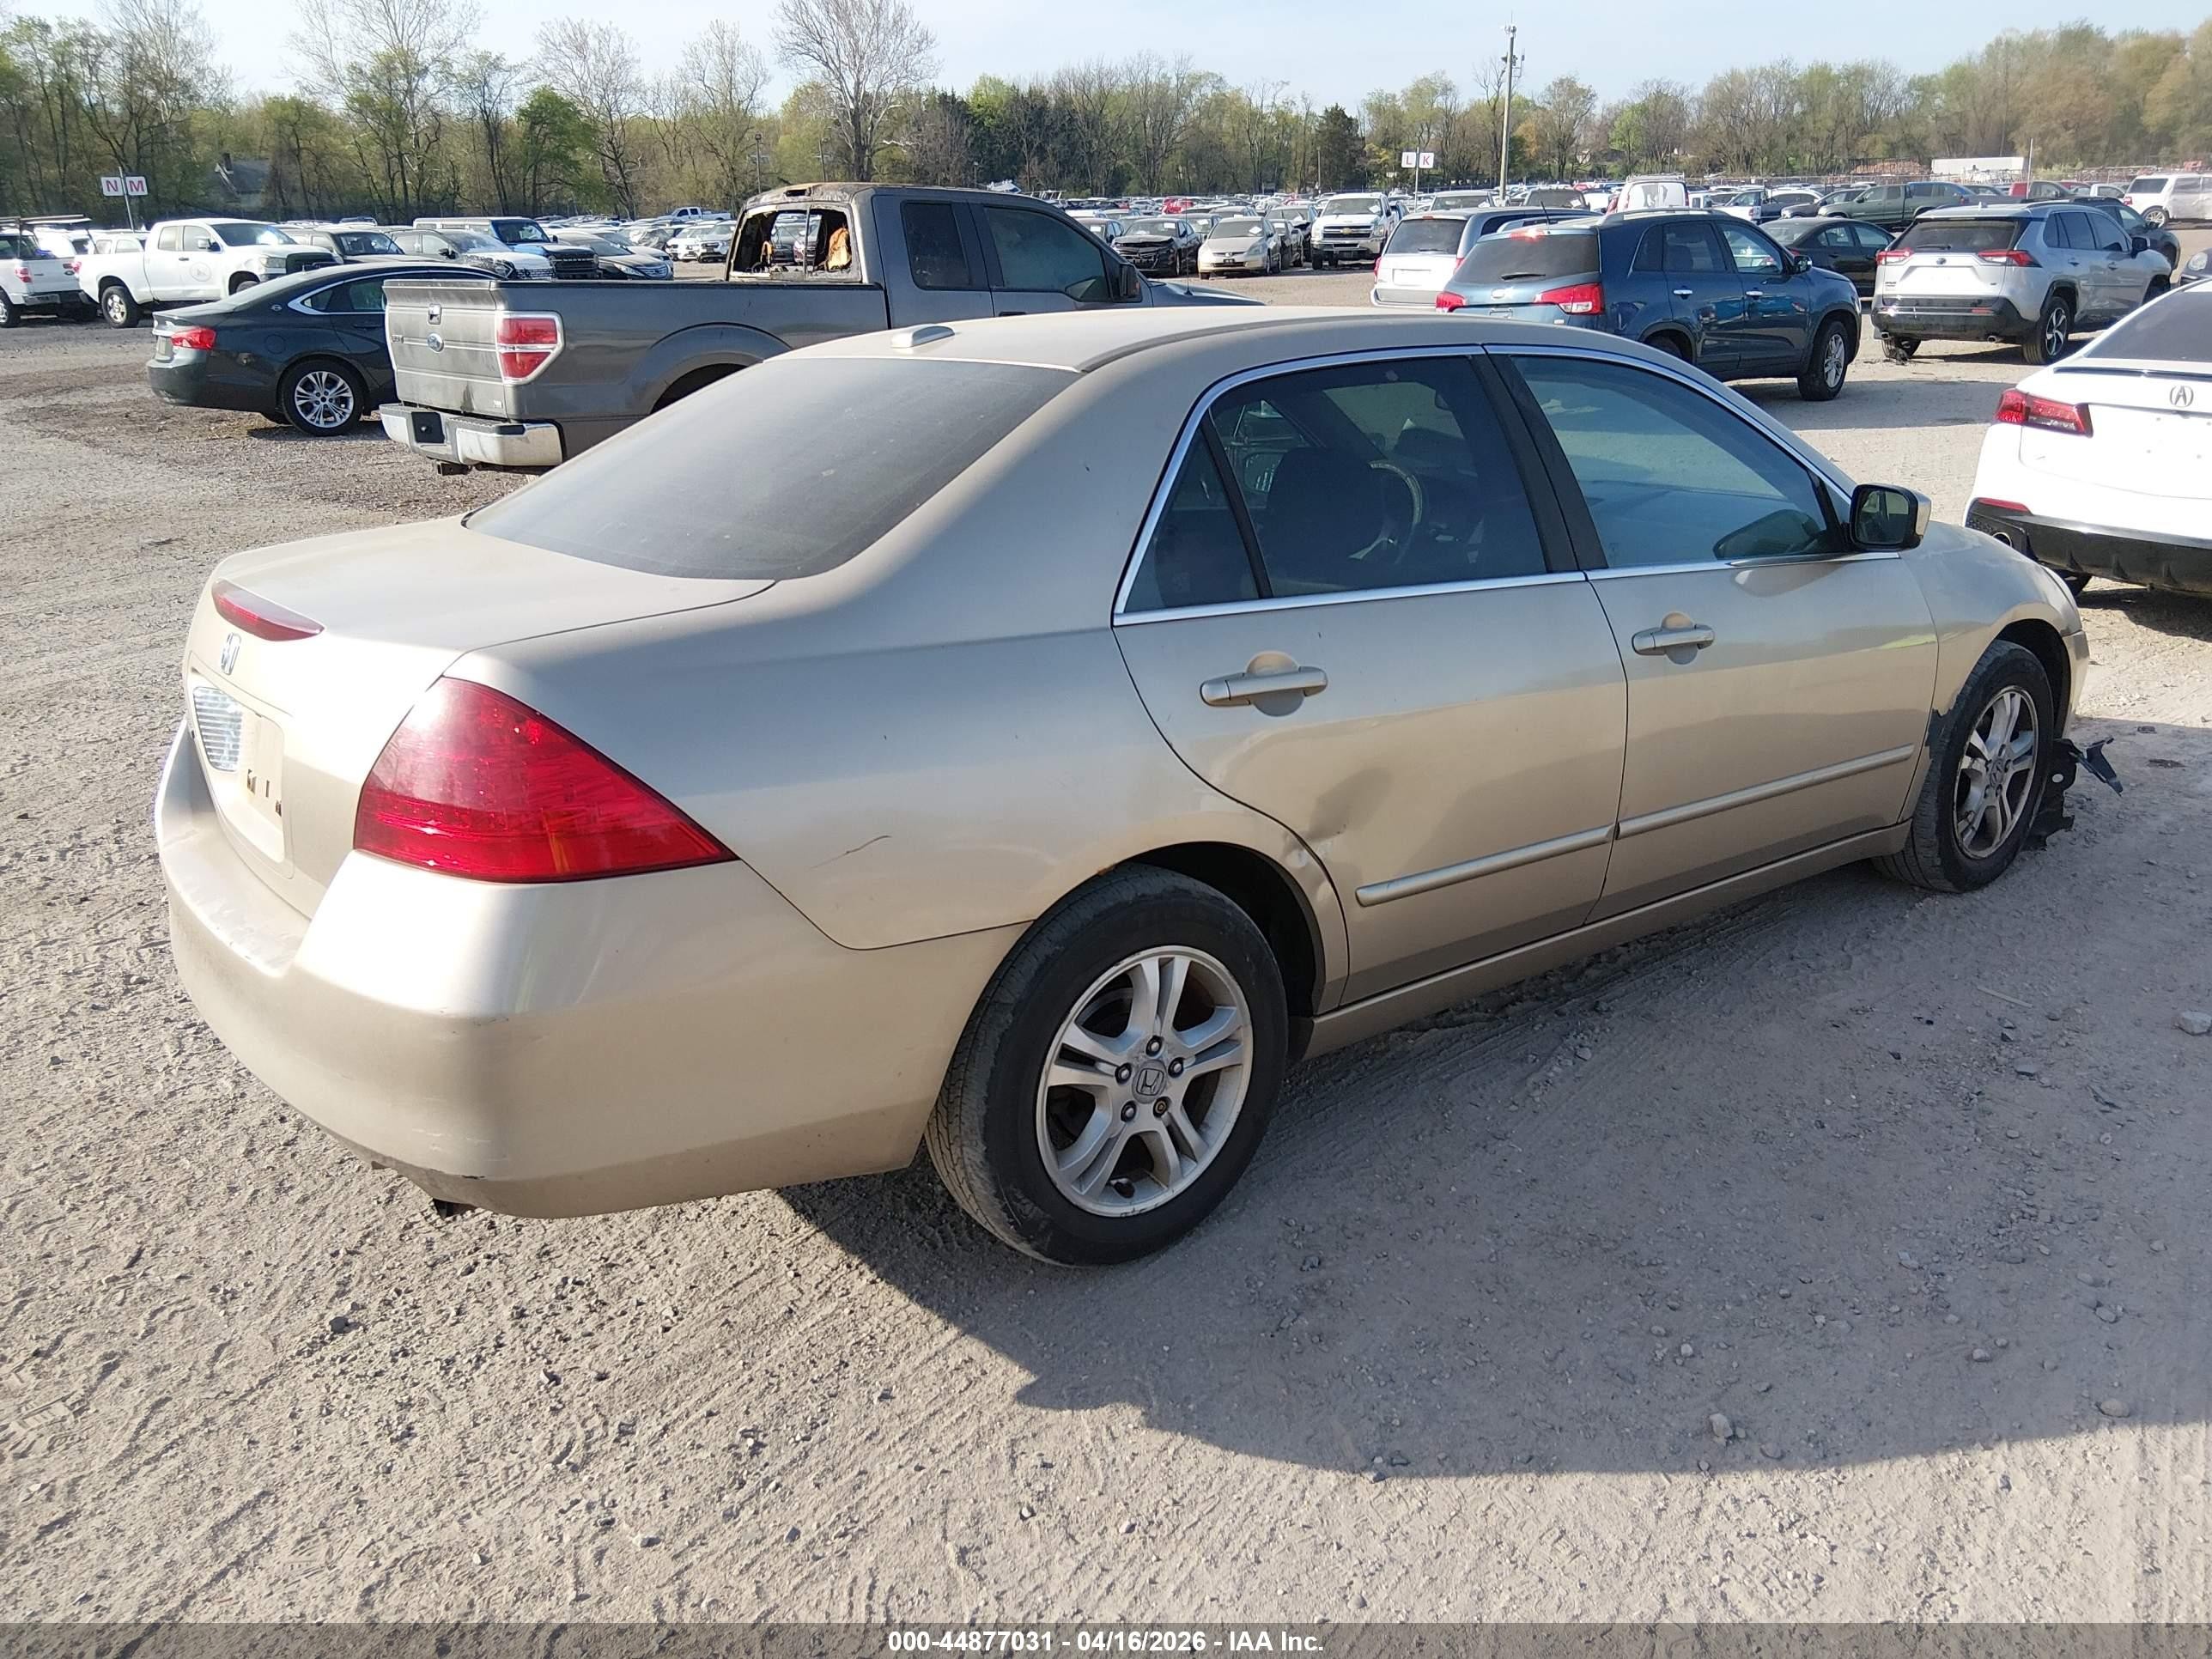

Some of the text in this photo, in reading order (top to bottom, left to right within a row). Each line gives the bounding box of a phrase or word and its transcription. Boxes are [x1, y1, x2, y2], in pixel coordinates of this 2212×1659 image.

[1406, 155, 1413, 166] L
[1423, 155, 1431, 166] K
[106, 179, 118, 192] N
[129, 179, 144, 192] M
